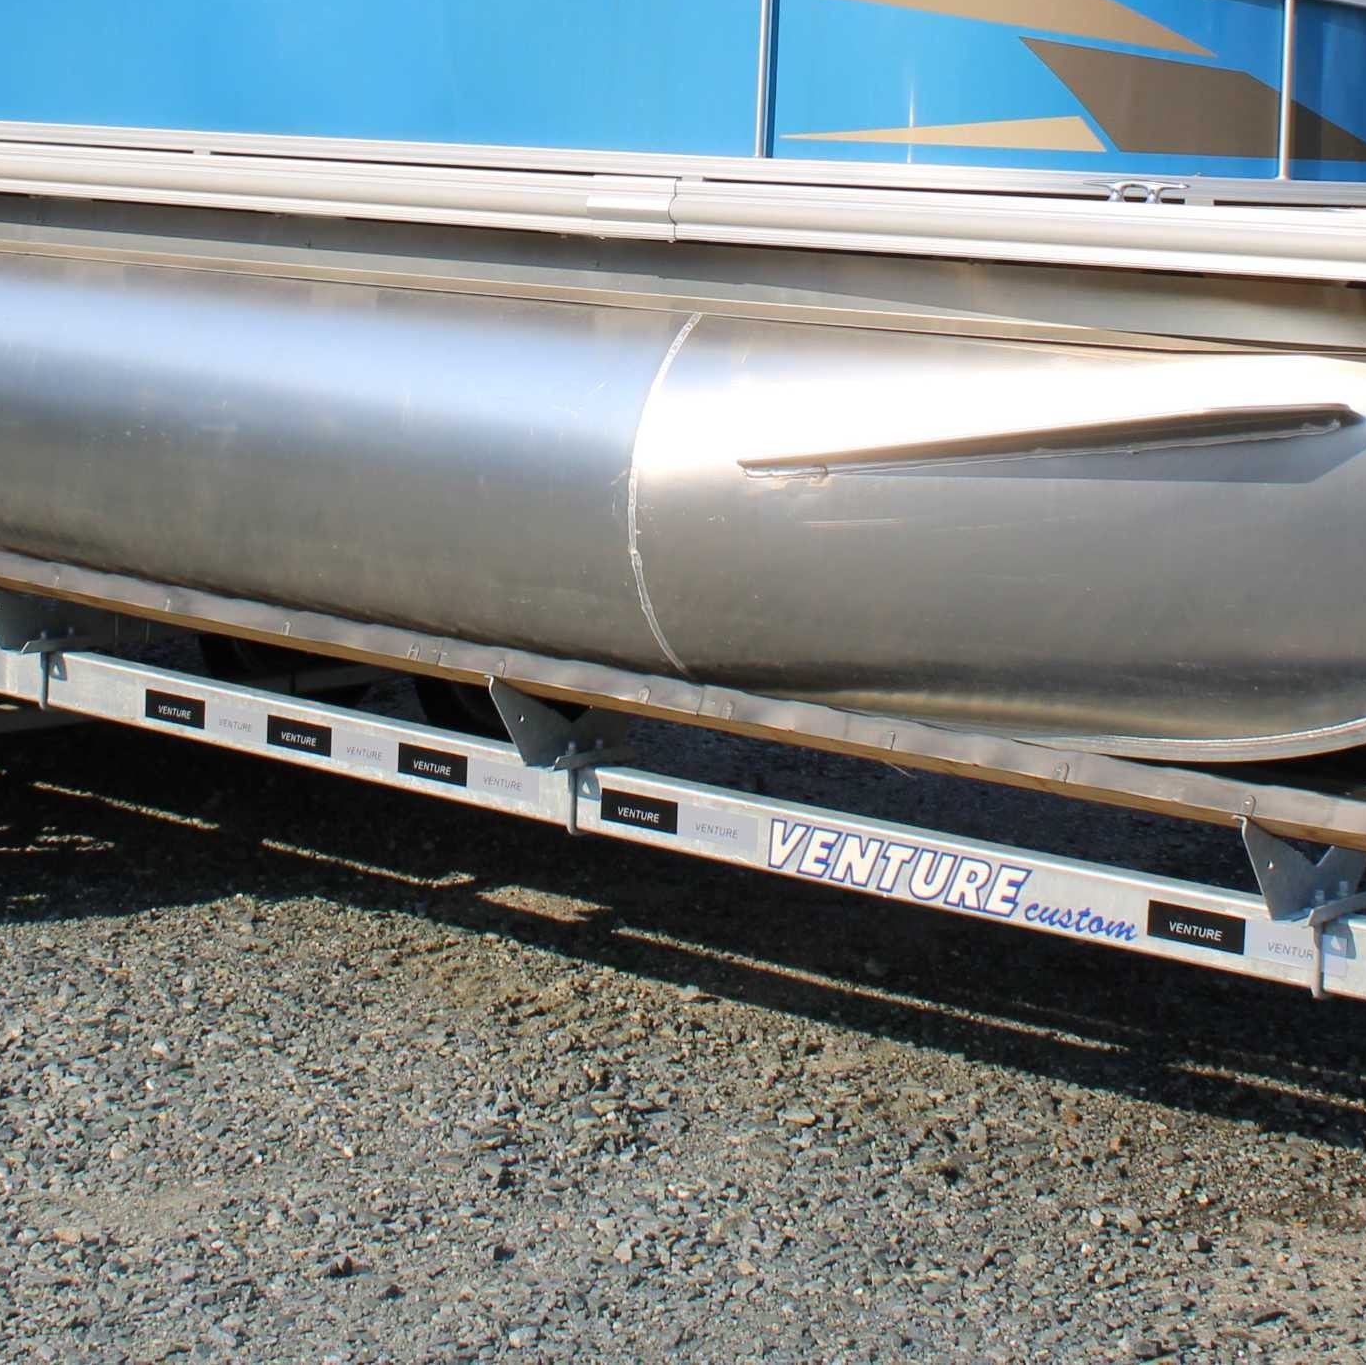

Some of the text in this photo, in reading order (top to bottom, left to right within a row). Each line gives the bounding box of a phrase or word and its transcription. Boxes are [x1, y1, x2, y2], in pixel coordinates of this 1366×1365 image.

[158, 704, 192, 720] VENTURE
[218, 718, 252, 733] VENTURE
[281, 731, 317, 747] VENTURE
[346, 745, 383, 761] VENTURE
[412, 759, 452, 777] VENTURE
[482, 775, 524, 792] VENTURE
[617, 806, 660, 824] VENTURE
[694, 822, 739, 840] VENTURE
[767, 818, 1138, 942] VENTURE custom
[1168, 920, 1224, 942] VENTURE
[1267, 941, 1315, 960] VENTUR
